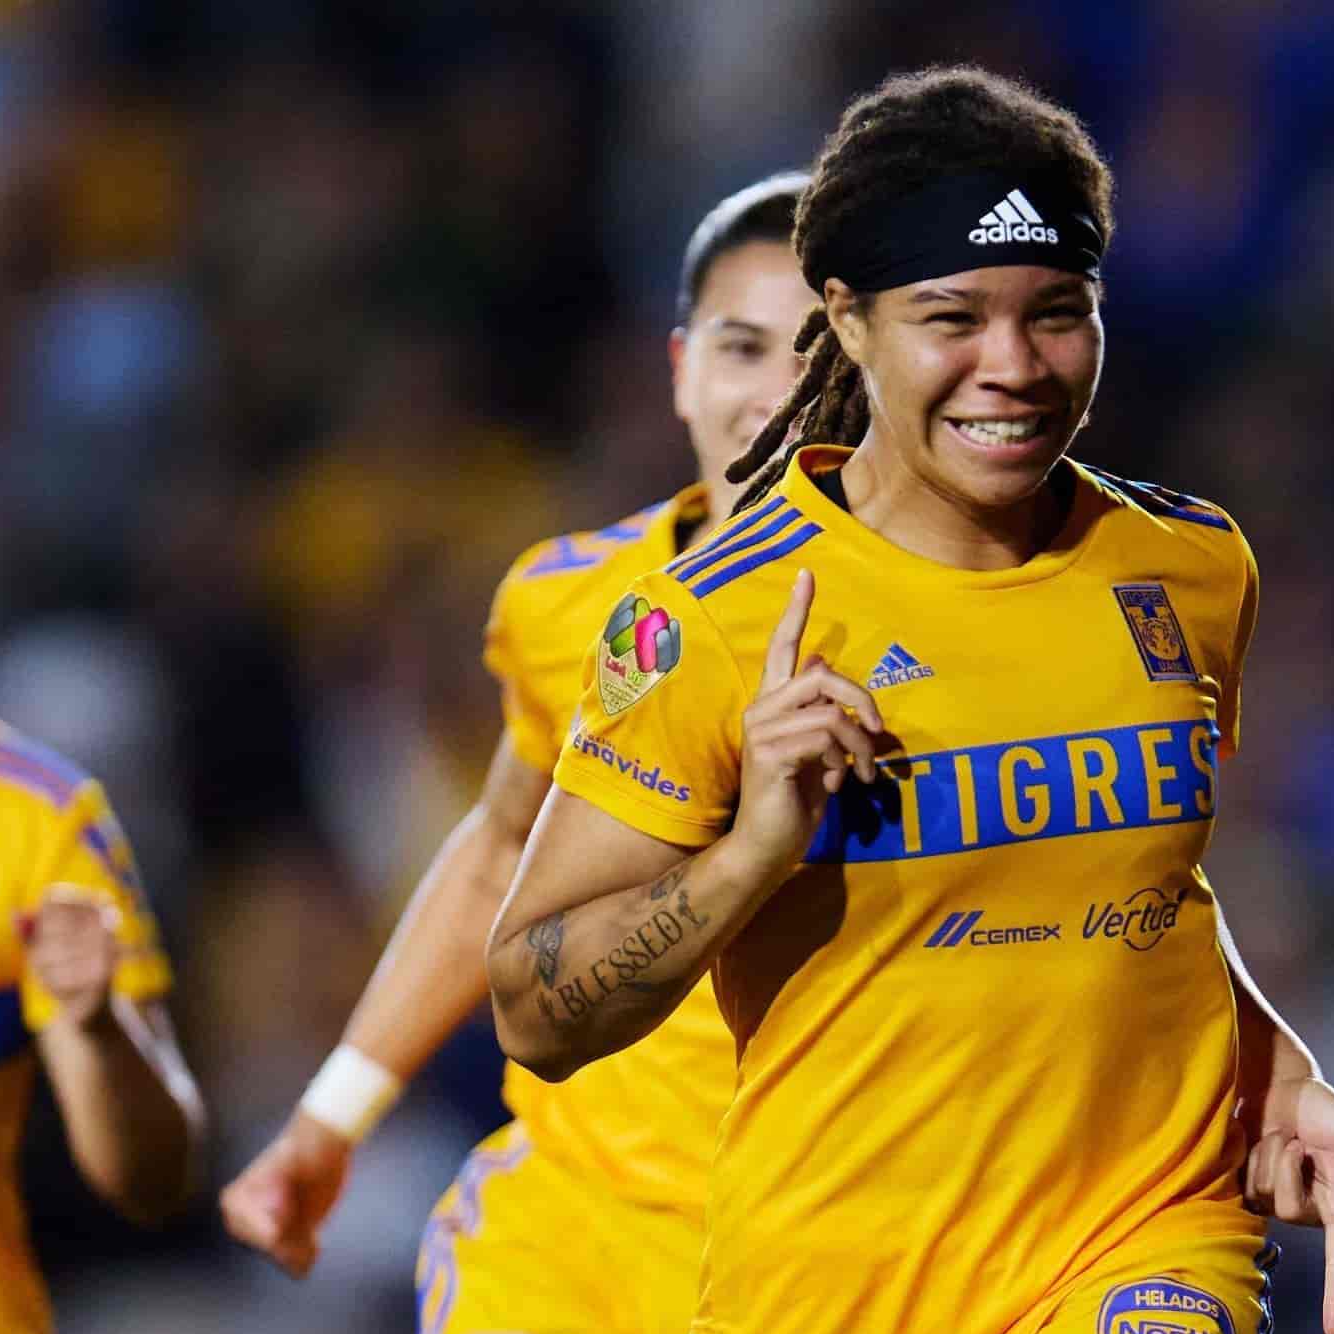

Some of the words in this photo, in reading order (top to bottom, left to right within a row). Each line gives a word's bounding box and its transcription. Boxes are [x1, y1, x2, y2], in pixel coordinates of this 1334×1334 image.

[968, 220, 1059, 245] adidas
[867, 663, 935, 690] adidas
[883, 726, 1215, 853] TIGRES
[970, 924, 1062, 946] CEMEX
[555, 910, 684, 1018] BLESSED
[1134, 1289, 1221, 1318] HELADOS
